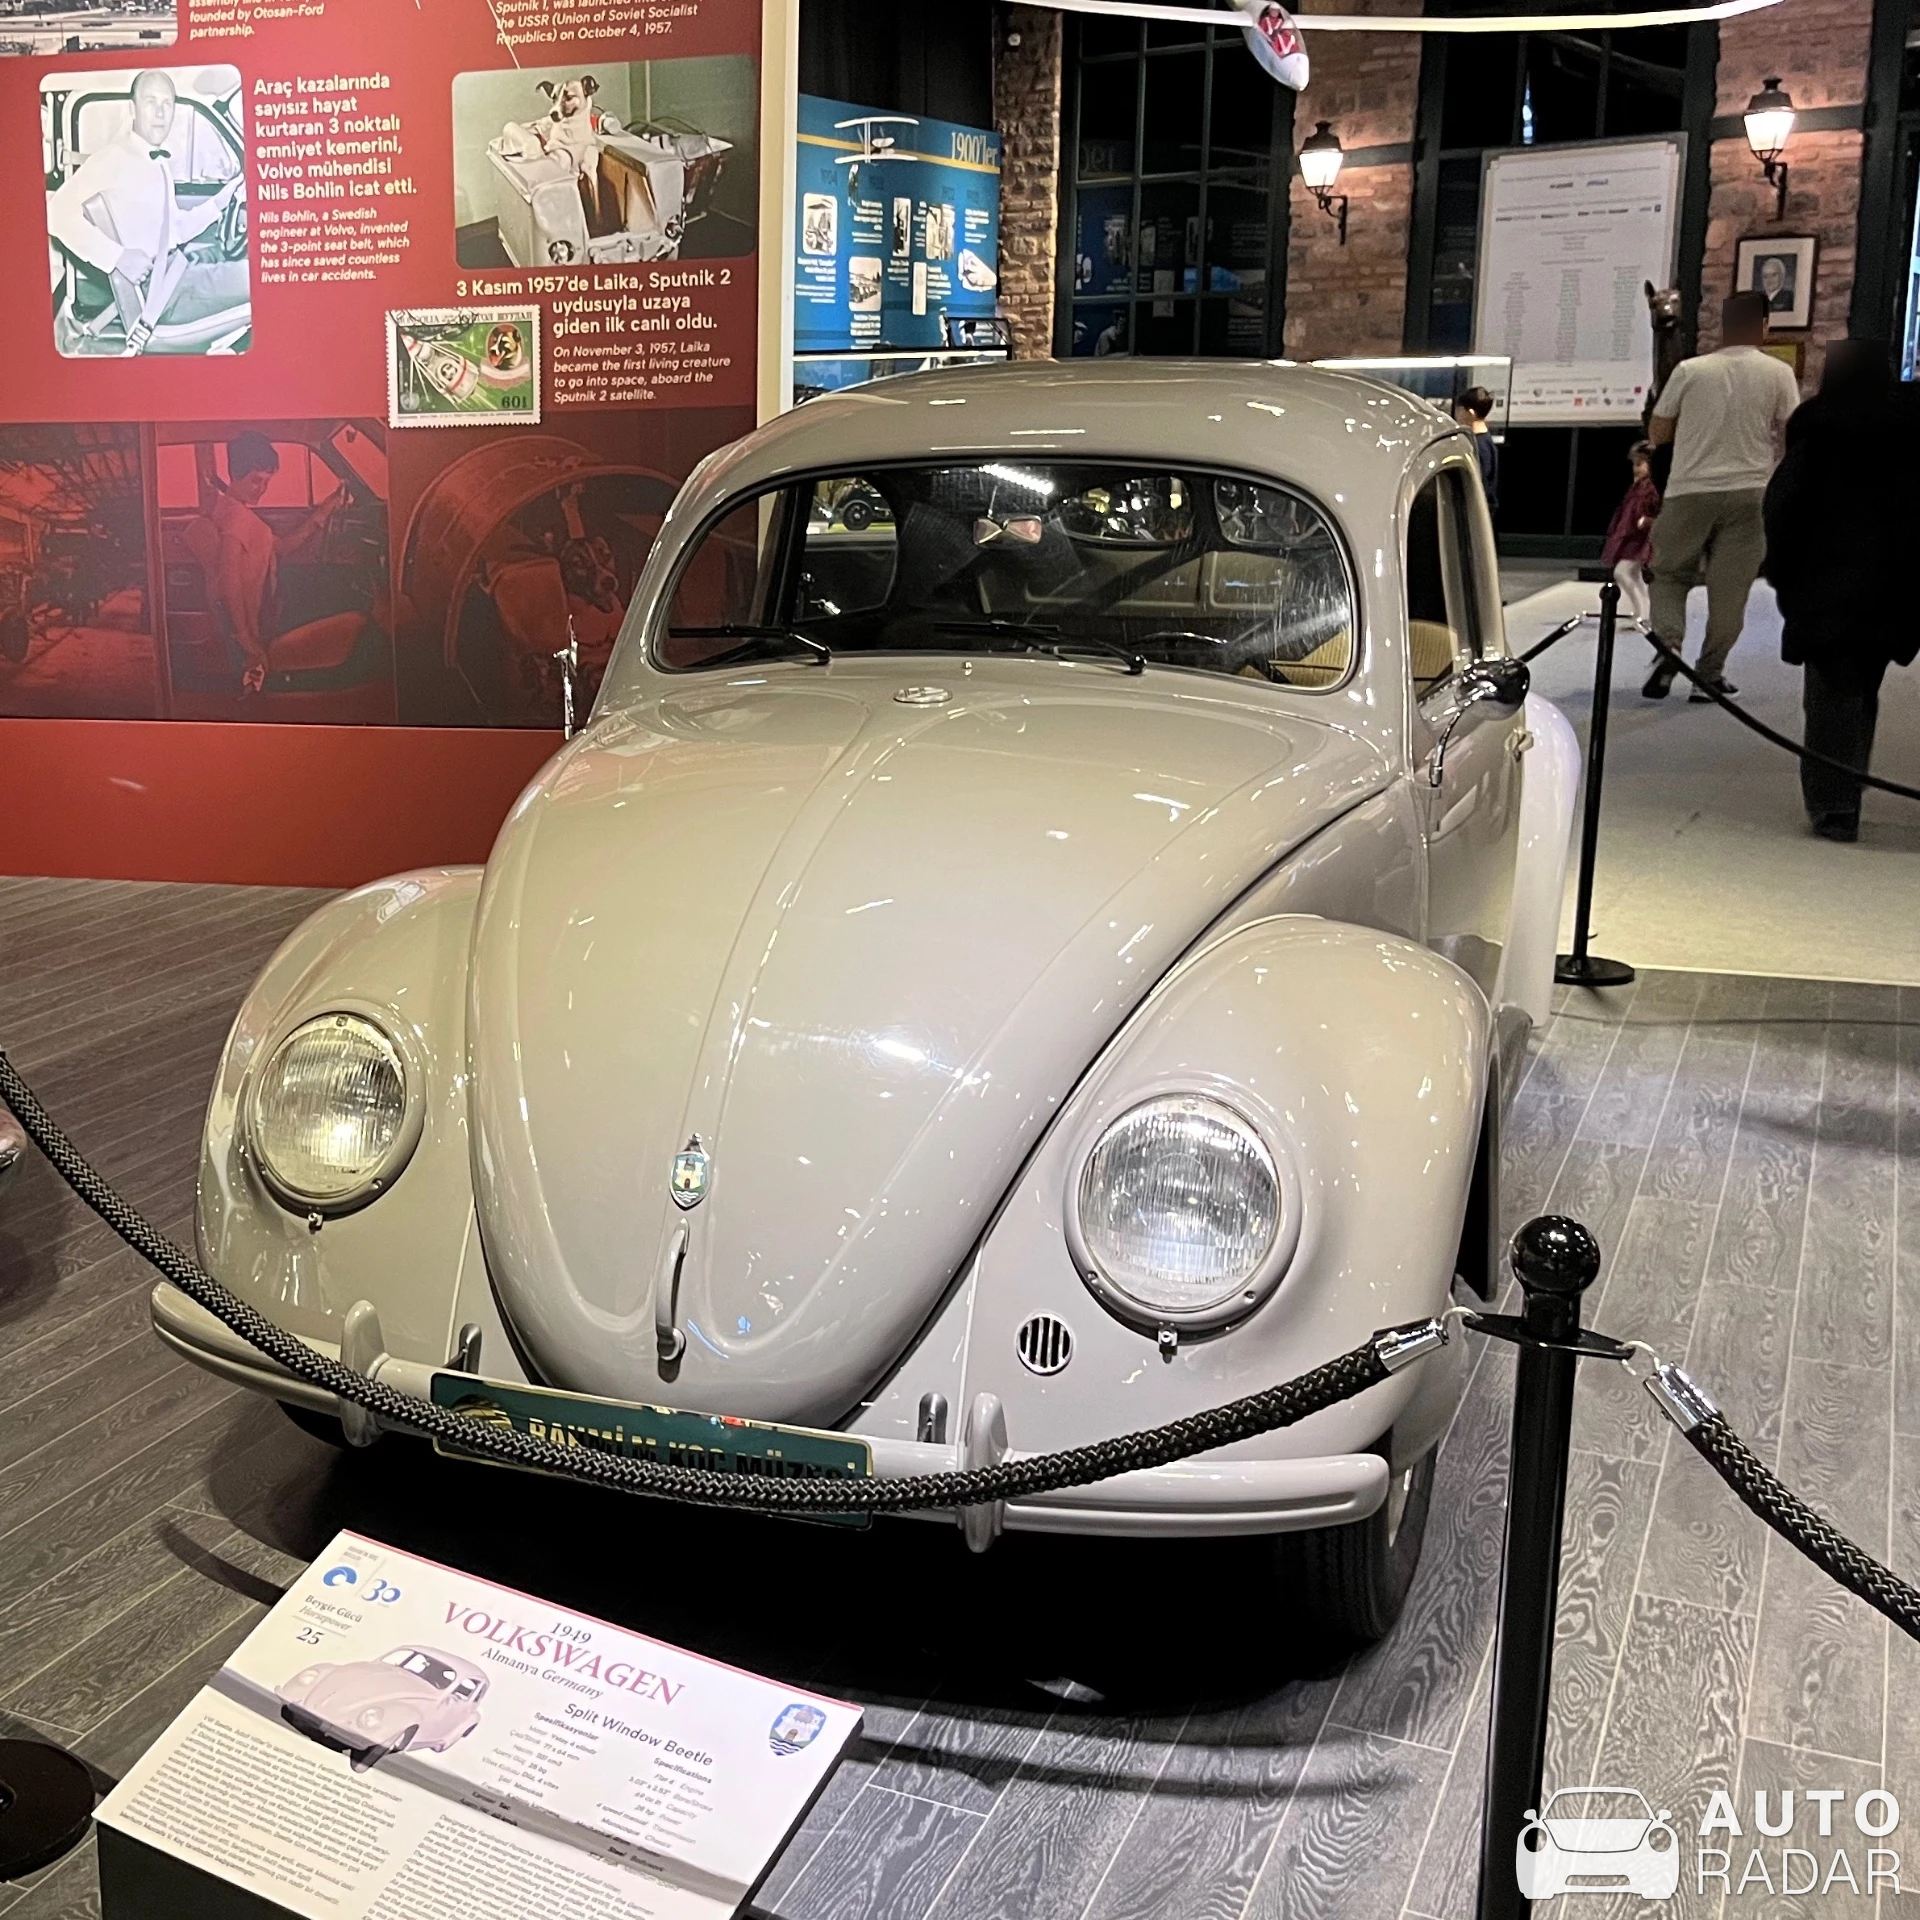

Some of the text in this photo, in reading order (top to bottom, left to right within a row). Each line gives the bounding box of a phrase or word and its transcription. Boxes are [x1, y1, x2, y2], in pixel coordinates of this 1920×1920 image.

[190, 4, 324, 22] founded by Otosan-Ford
[496, 4, 698, 29] the USSR (Union of Soviet Socialist
[190, 24, 255, 40] partnership.
[496, 22, 672, 46] Republics) on October 4, 1957.
[254, 72, 390, 98] Araç kazalarında
[254, 96, 358, 119] sayısız hayat
[256, 114, 400, 137] kurtaran 3 noktalı
[256, 135, 402, 161] emniyet kemerini,
[952, 132, 998, 167] 1900'ler
[257, 157, 392, 179] Volvo mühendisi
[258, 177, 417, 200] Nils Bohlin icat etti.
[259, 208, 377, 223] Nils Bohlin, a Swedish
[259, 221, 408, 240] engineer at Volvo, invented
[260, 236, 410, 254] the 3-point seat belt, which
[260, 252, 400, 268] has since saved countless
[261, 269, 376, 283] lives in car accidents.
[456, 268, 731, 296] 3 Kasım 1957'de Laika, Sputnik 2
[552, 296, 691, 317] uydusuyla uzaya
[553, 312, 718, 339] giden ilk canlı oldu.
[553, 341, 710, 357] On November 3, 1957, Laika
[553, 356, 731, 373] became the first living creature
[554, 372, 714, 389] to go into space, aboard the
[554, 389, 656, 404] Sputnik 2 satellite.
[299, 1606, 351, 1631] Horsepower
[305, 1595, 362, 1622] Beygir Gücü
[296, 1627, 324, 1644] 25
[550, 1622, 592, 1644] 1949
[444, 1603, 685, 1705] VOLKSWAGEN
[481, 1647, 604, 1700] Almanya Germany
[565, 1703, 713, 1766] Split Window Beetle
[654, 1757, 712, 1784] Specifications
